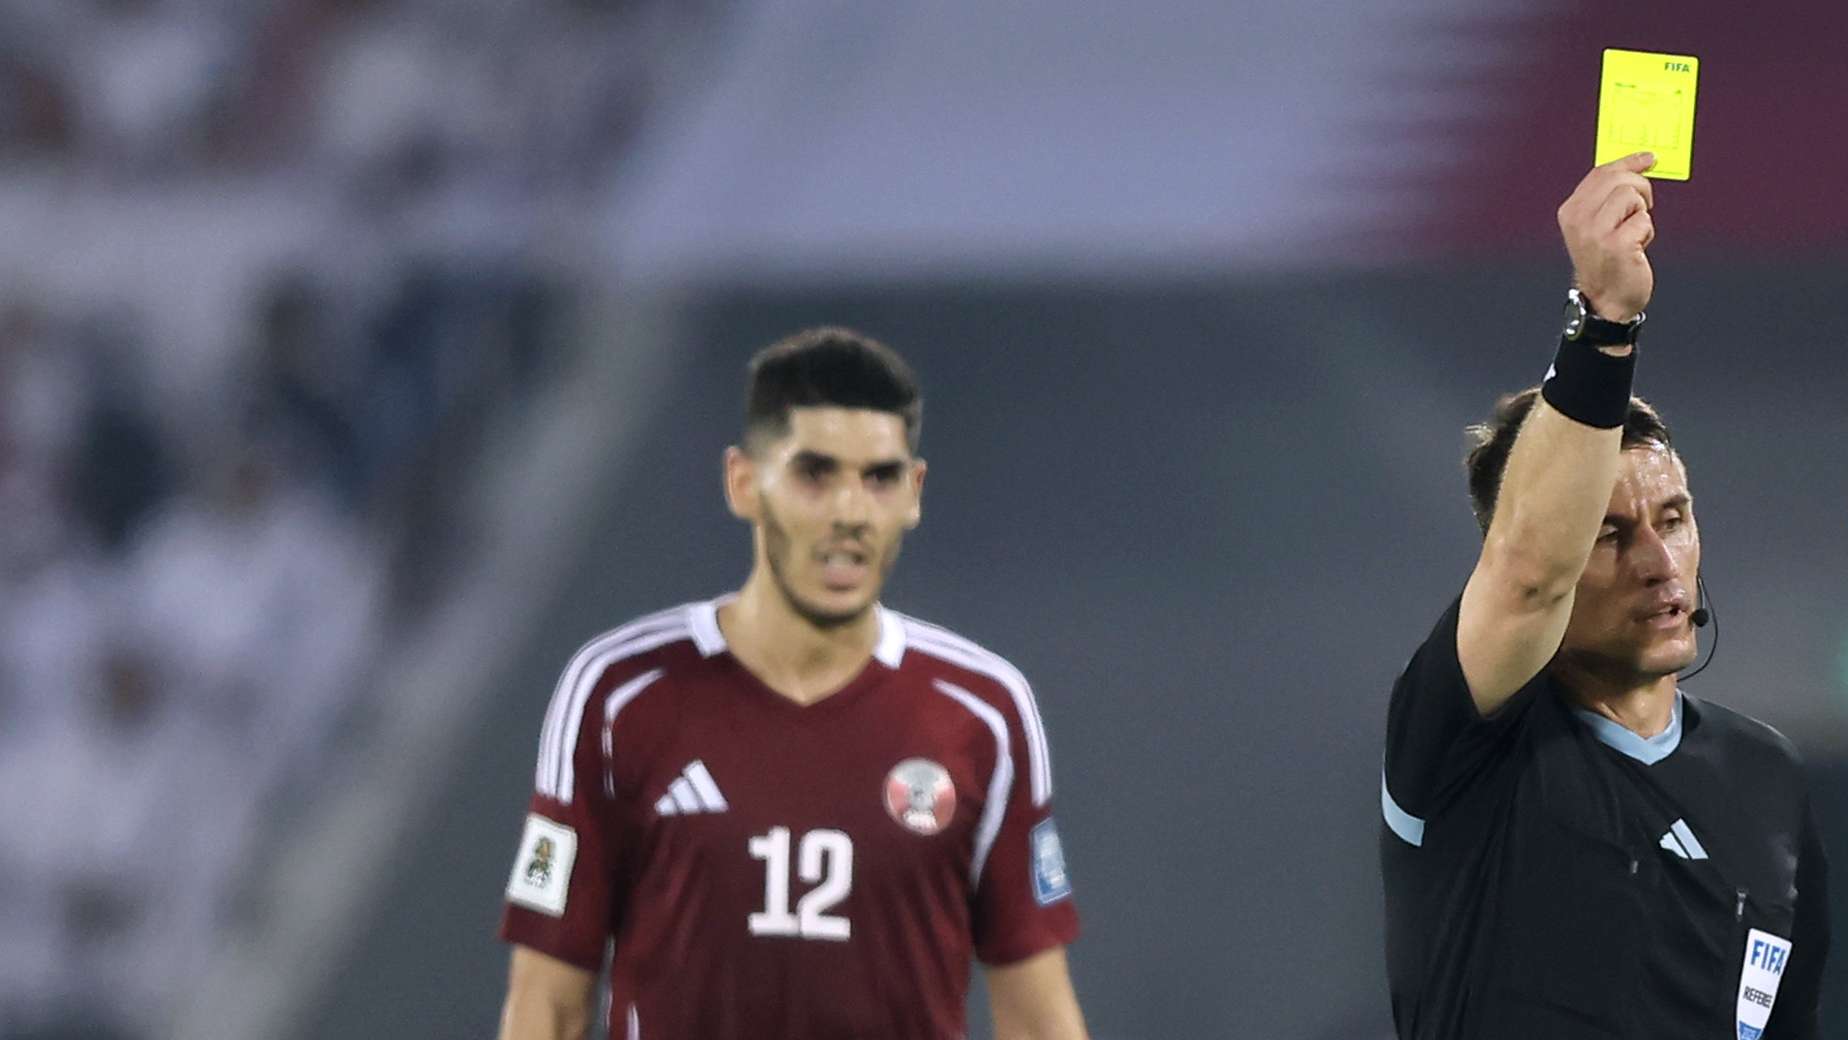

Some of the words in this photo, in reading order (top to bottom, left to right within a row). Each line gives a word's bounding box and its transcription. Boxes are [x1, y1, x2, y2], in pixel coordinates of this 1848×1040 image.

[1664, 62, 1690, 72] FIFA
[747, 825, 854, 942] 12
[1750, 939, 1787, 976] FIFA
